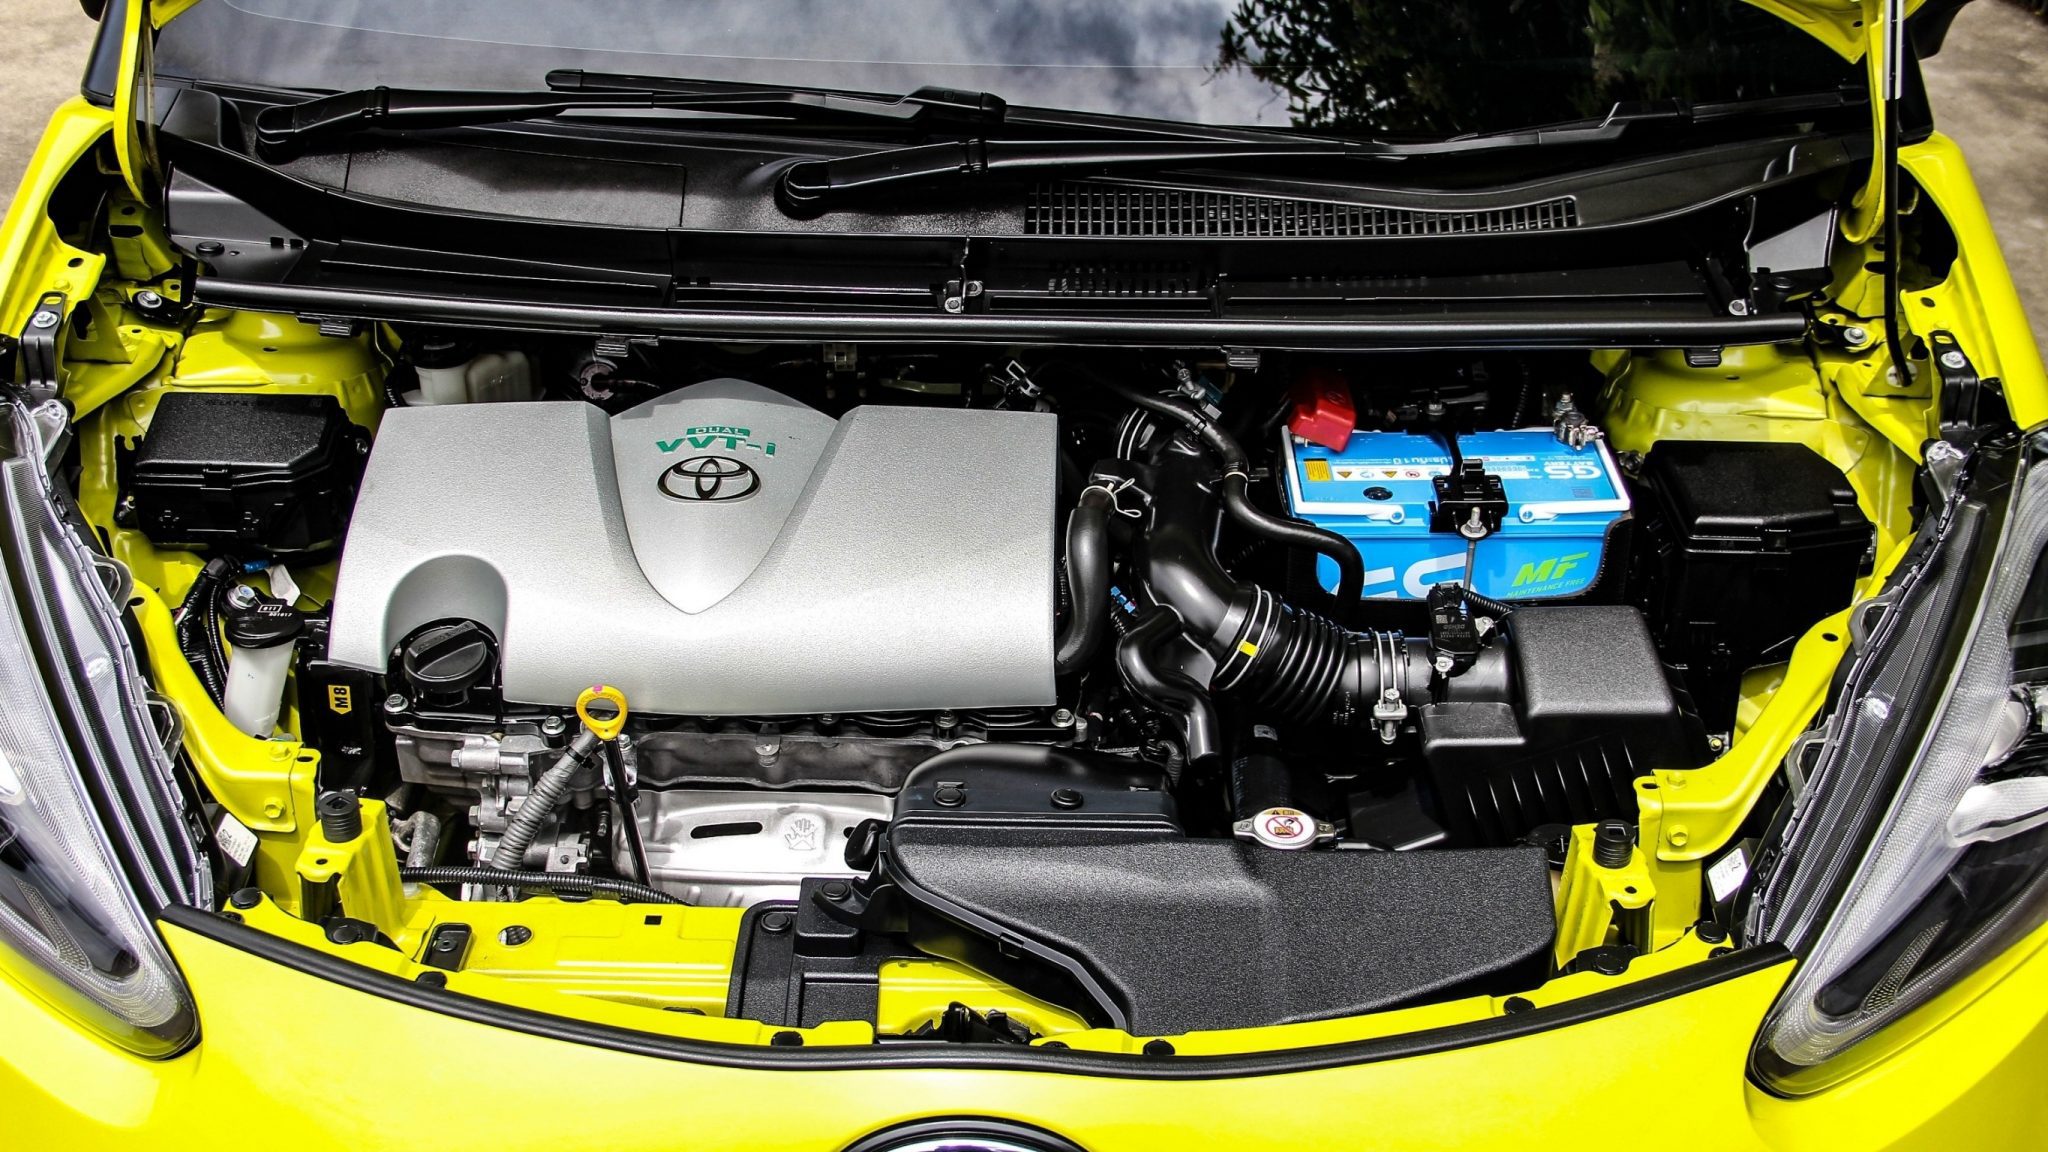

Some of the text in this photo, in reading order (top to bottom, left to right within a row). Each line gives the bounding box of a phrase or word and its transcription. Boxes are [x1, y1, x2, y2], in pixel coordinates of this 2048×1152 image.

[695, 427, 744, 436] DUAL
[1543, 465, 1602, 480] GS
[1511, 551, 1590, 588] MF
[1505, 576, 1587, 599] MAINTENANCE FREE
[333, 687, 349, 709] M8
